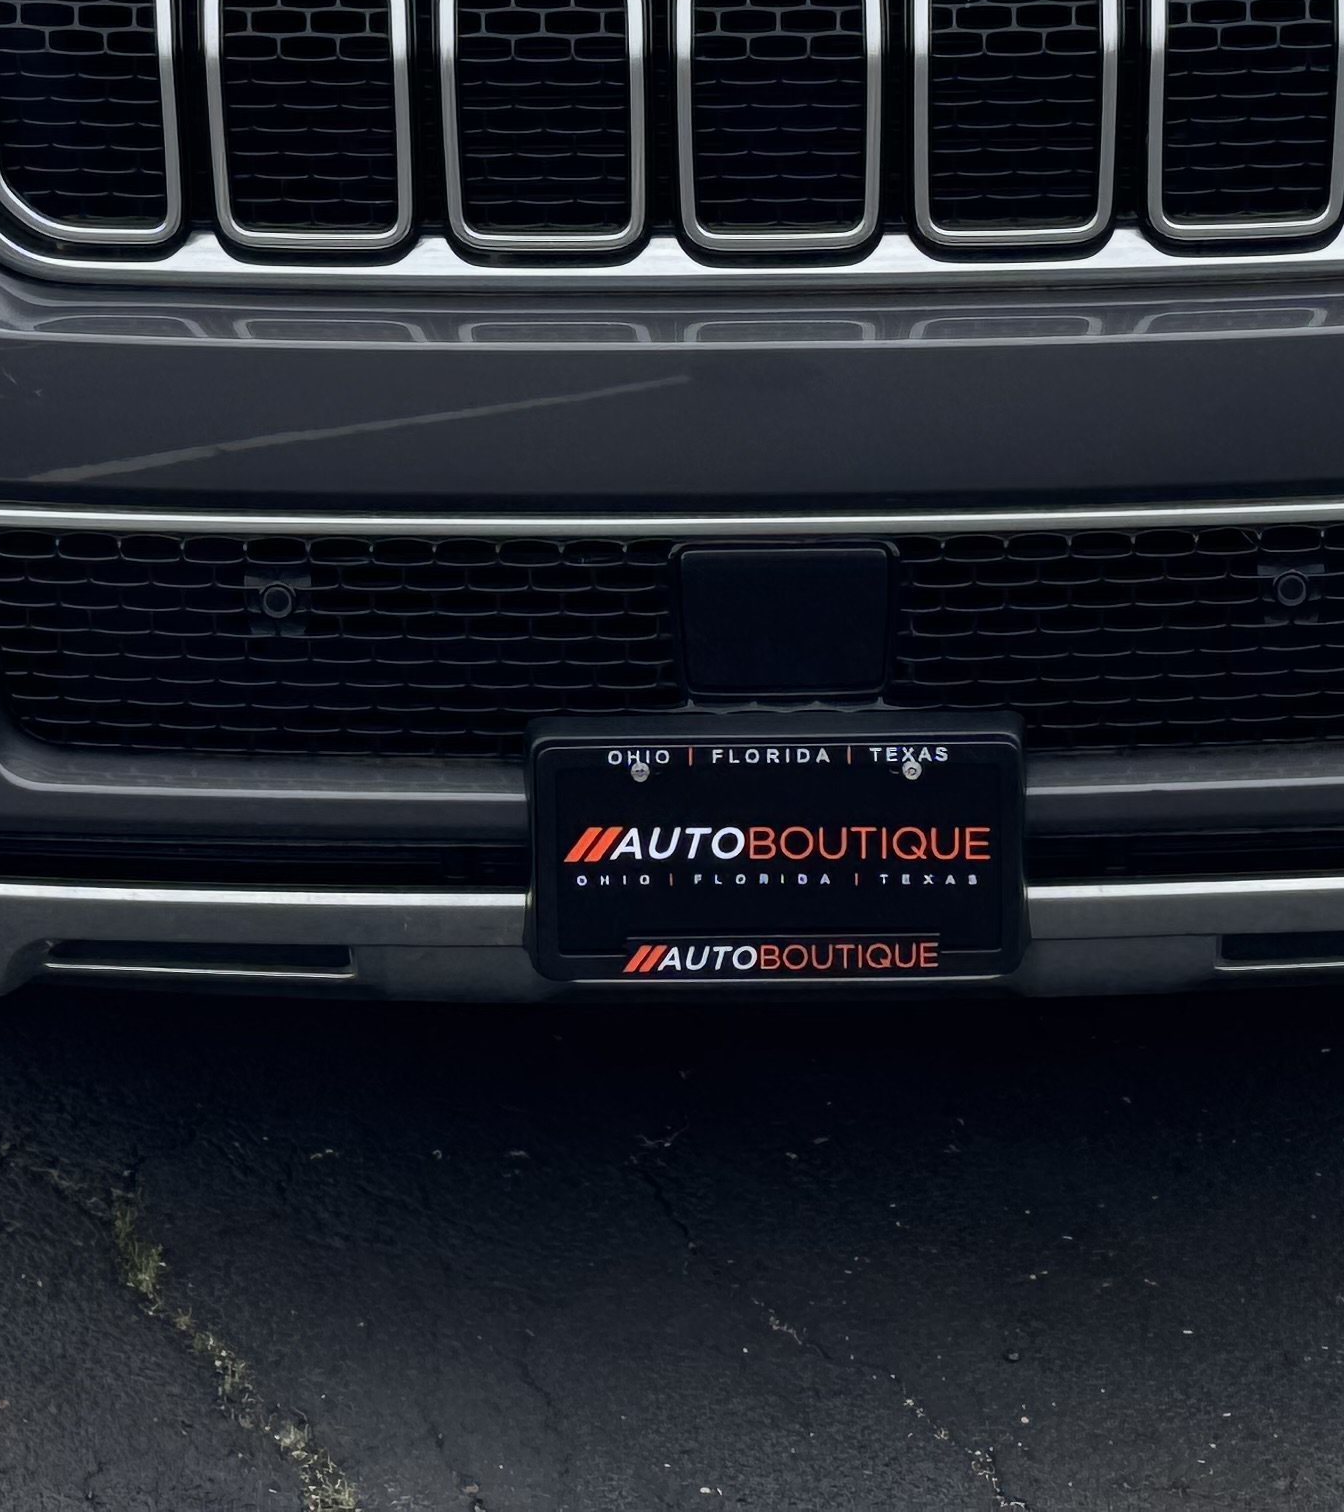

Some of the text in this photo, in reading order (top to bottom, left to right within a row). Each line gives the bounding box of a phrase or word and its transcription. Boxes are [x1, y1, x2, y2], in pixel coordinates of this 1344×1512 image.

[607, 745, 950, 766] OHIO FLORIDA TEXAS
[609, 826, 992, 861] AUTOBOUTIQUE
[575, 872, 979, 887] OHIO FLORIDA TEXAS
[656, 941, 940, 972] AUTOBOUTIQUE
